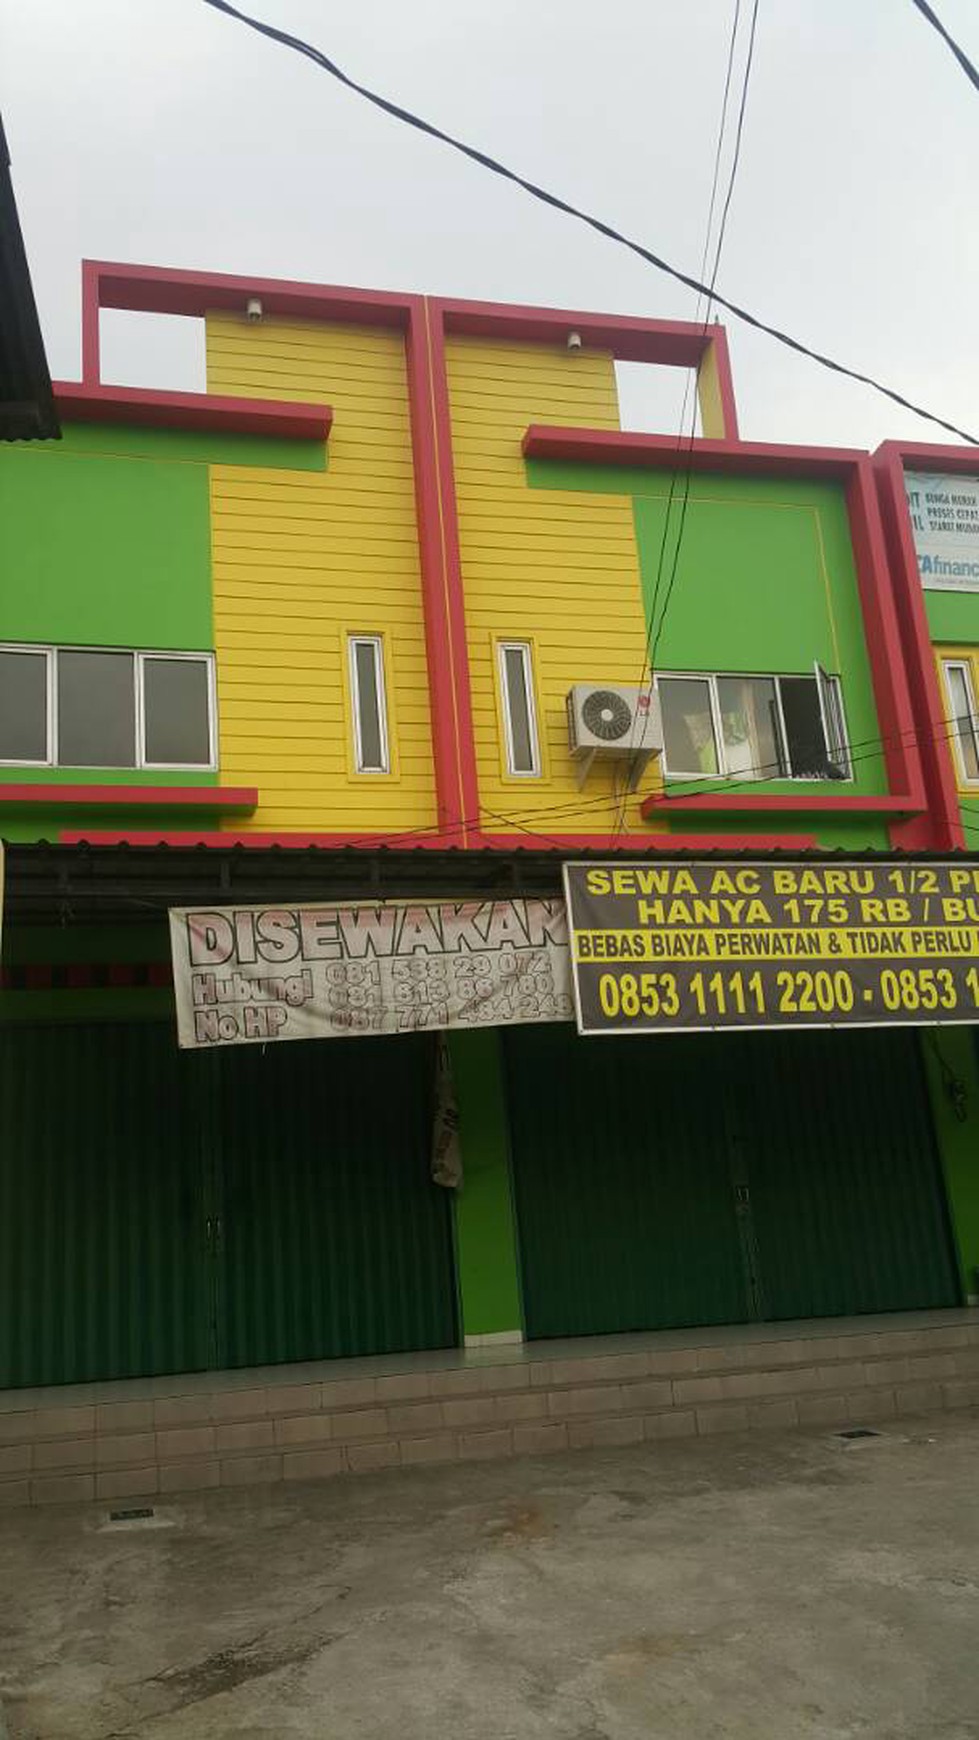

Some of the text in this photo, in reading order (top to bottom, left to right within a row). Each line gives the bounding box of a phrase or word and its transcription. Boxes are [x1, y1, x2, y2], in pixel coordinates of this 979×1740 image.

[587, 870, 979, 895] SEWA AC BARU 1/2 P
[638, 899, 772, 925] HANYA
[784, 899, 849, 923] 175
[860, 899, 911, 922] RB
[923, 898, 930, 922] /
[186, 899, 569, 966] DISEWAKAN
[578, 934, 646, 957] BEBAS
[651, 933, 710, 956] BIAYA
[715, 931, 821, 955] PERWATAN
[828, 931, 842, 953] &
[847, 931, 906, 953] TIDAK
[912, 930, 971, 952] PERLU
[192, 968, 314, 1007] Hubungi
[325, 960, 381, 986] 081
[600, 973, 680, 1017] 0853
[690, 971, 767, 1014] 1111
[777, 970, 854, 1012] 2200
[881, 968, 957, 1010] 0853
[194, 1009, 239, 1042] No
[244, 1006, 288, 1038] HP
